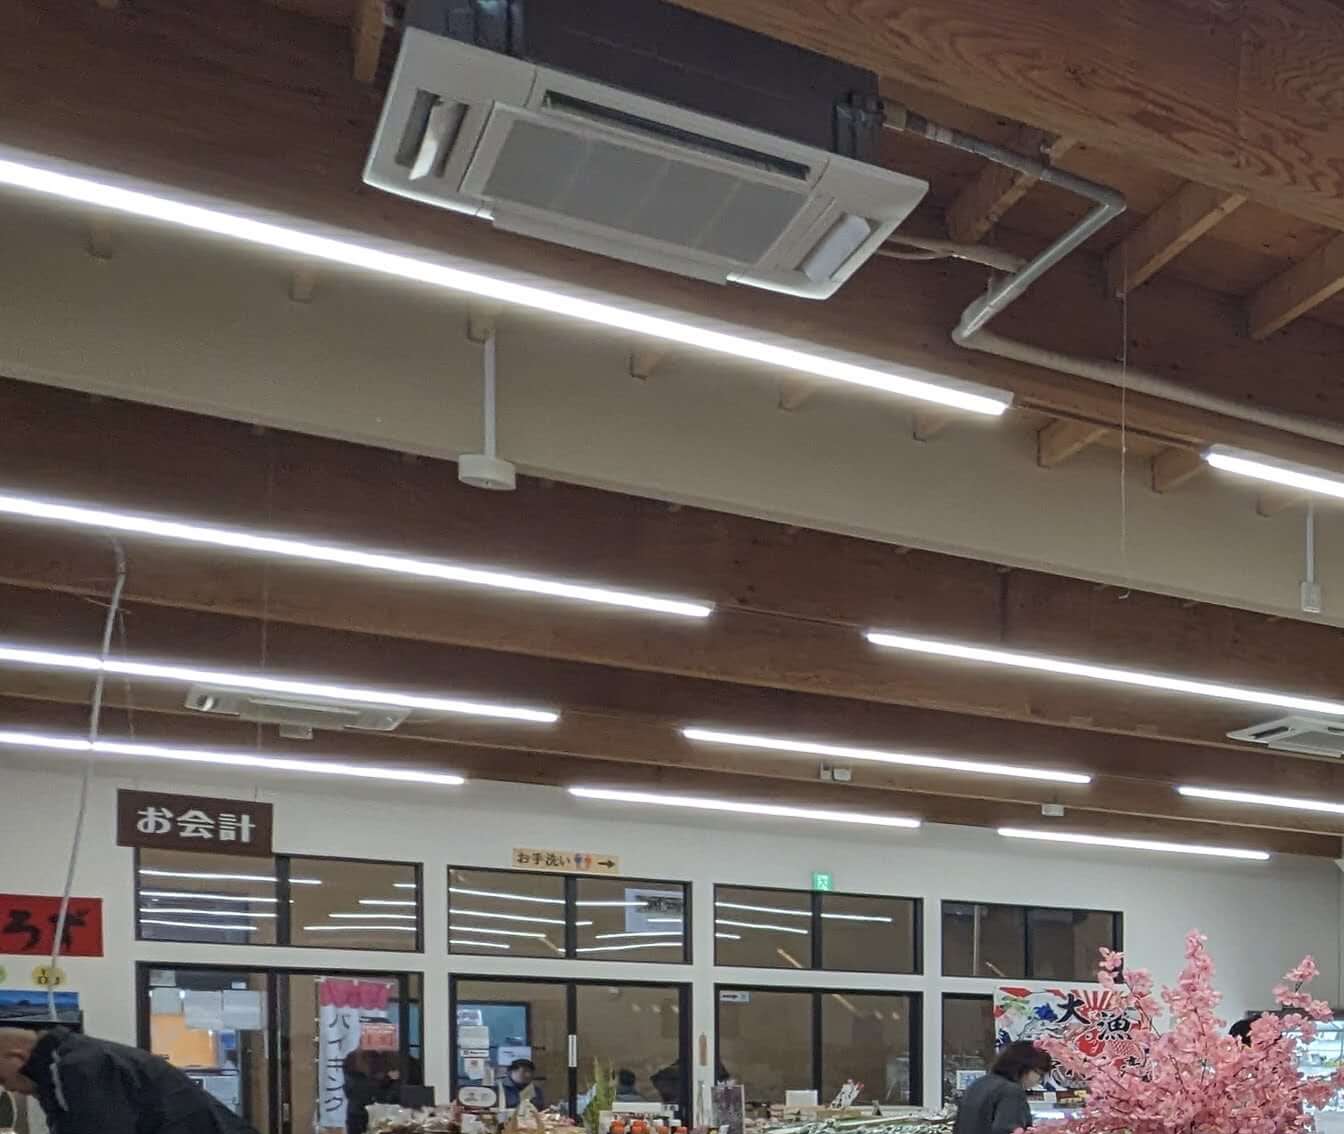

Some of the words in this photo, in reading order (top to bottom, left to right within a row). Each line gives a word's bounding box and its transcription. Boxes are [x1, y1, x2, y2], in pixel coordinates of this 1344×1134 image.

[136, 805, 256, 843] お会計
[516, 851, 571, 867] お手洗い
